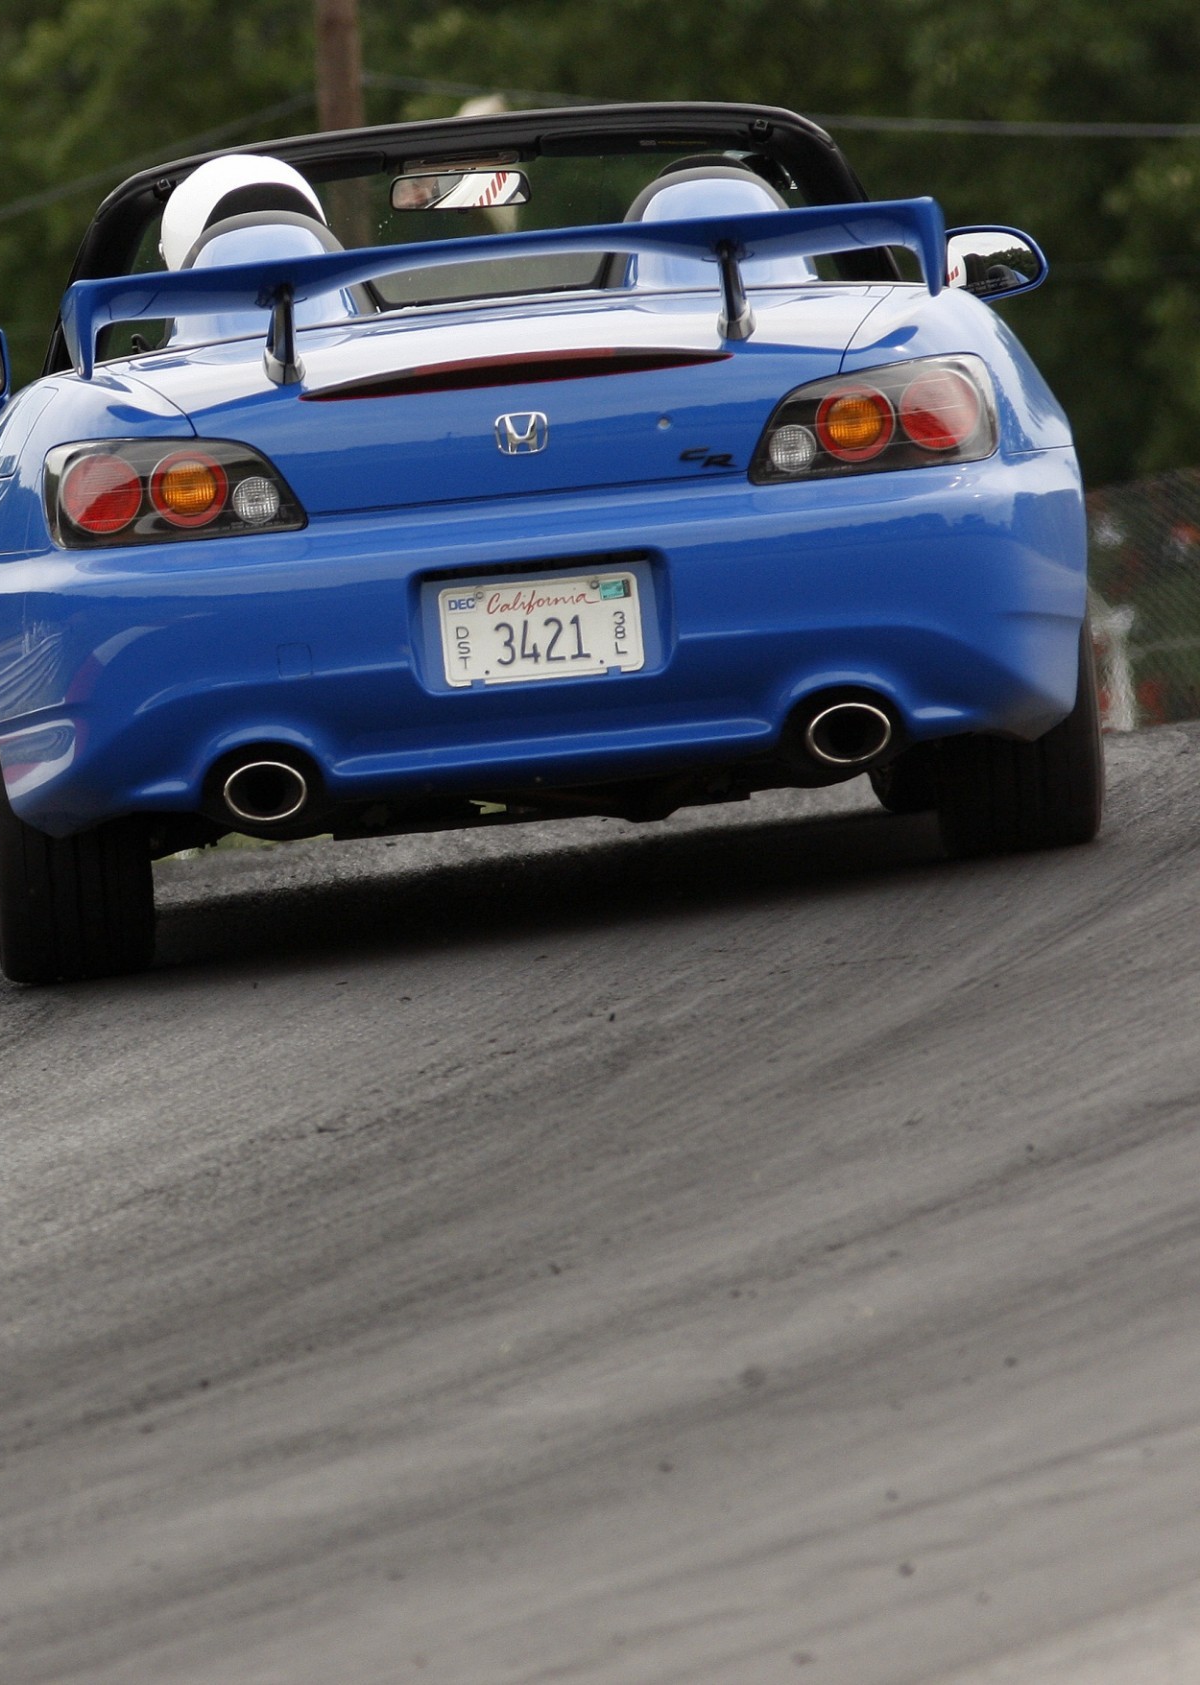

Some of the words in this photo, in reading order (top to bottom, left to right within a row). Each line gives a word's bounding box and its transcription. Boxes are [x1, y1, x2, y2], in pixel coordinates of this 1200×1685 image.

[448, 597, 476, 611] DEC
[486, 590, 600, 615] California
[494, 614, 591, 666] 3421
